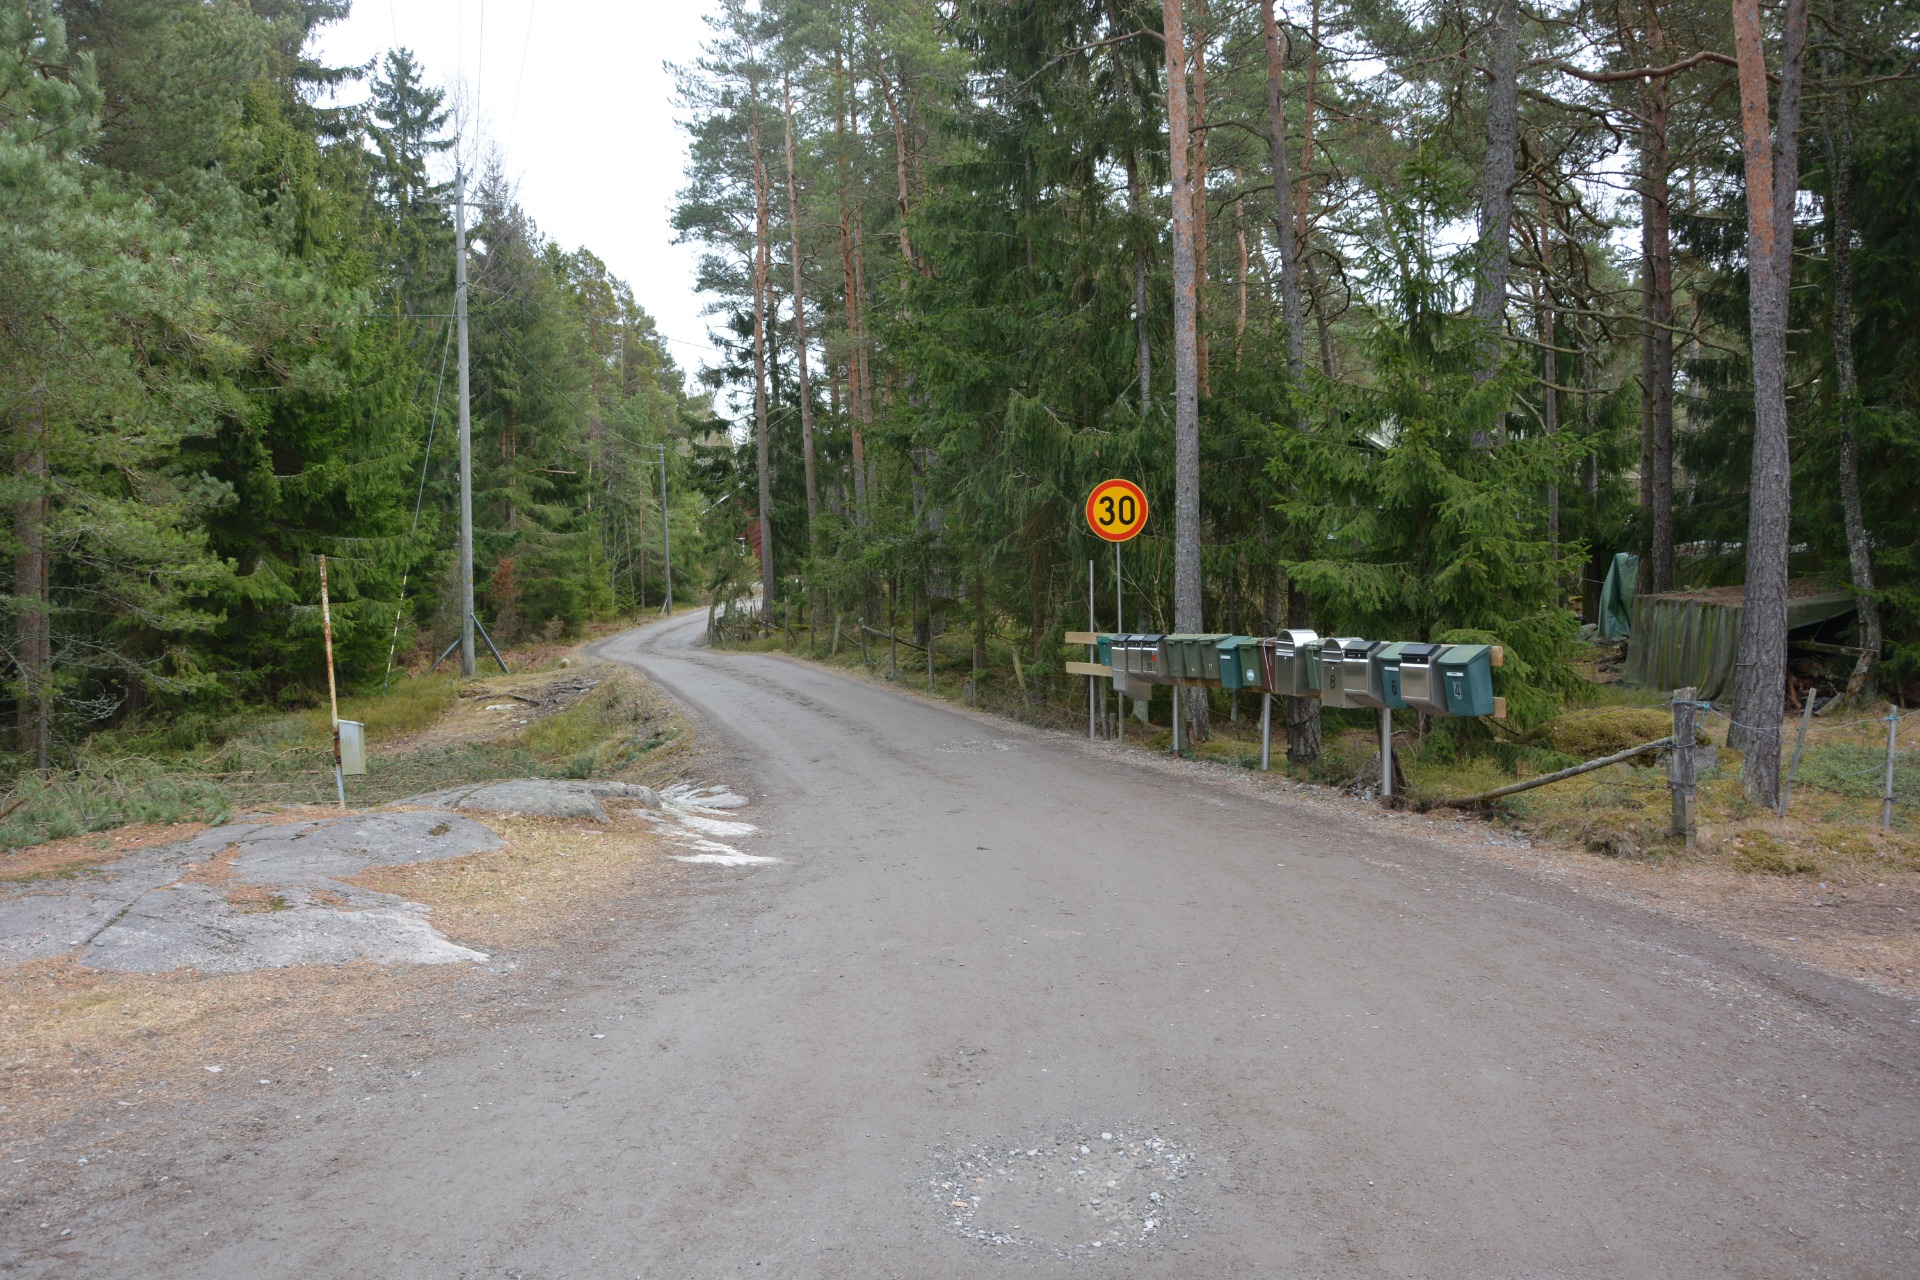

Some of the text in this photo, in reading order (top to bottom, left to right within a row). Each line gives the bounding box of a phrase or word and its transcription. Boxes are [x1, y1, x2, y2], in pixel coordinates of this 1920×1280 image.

[1099, 496, 1136, 526] 30
[1330, 675, 1335, 689] 8
[1391, 680, 1397, 695] 6
[1454, 682, 1461, 698] 4
